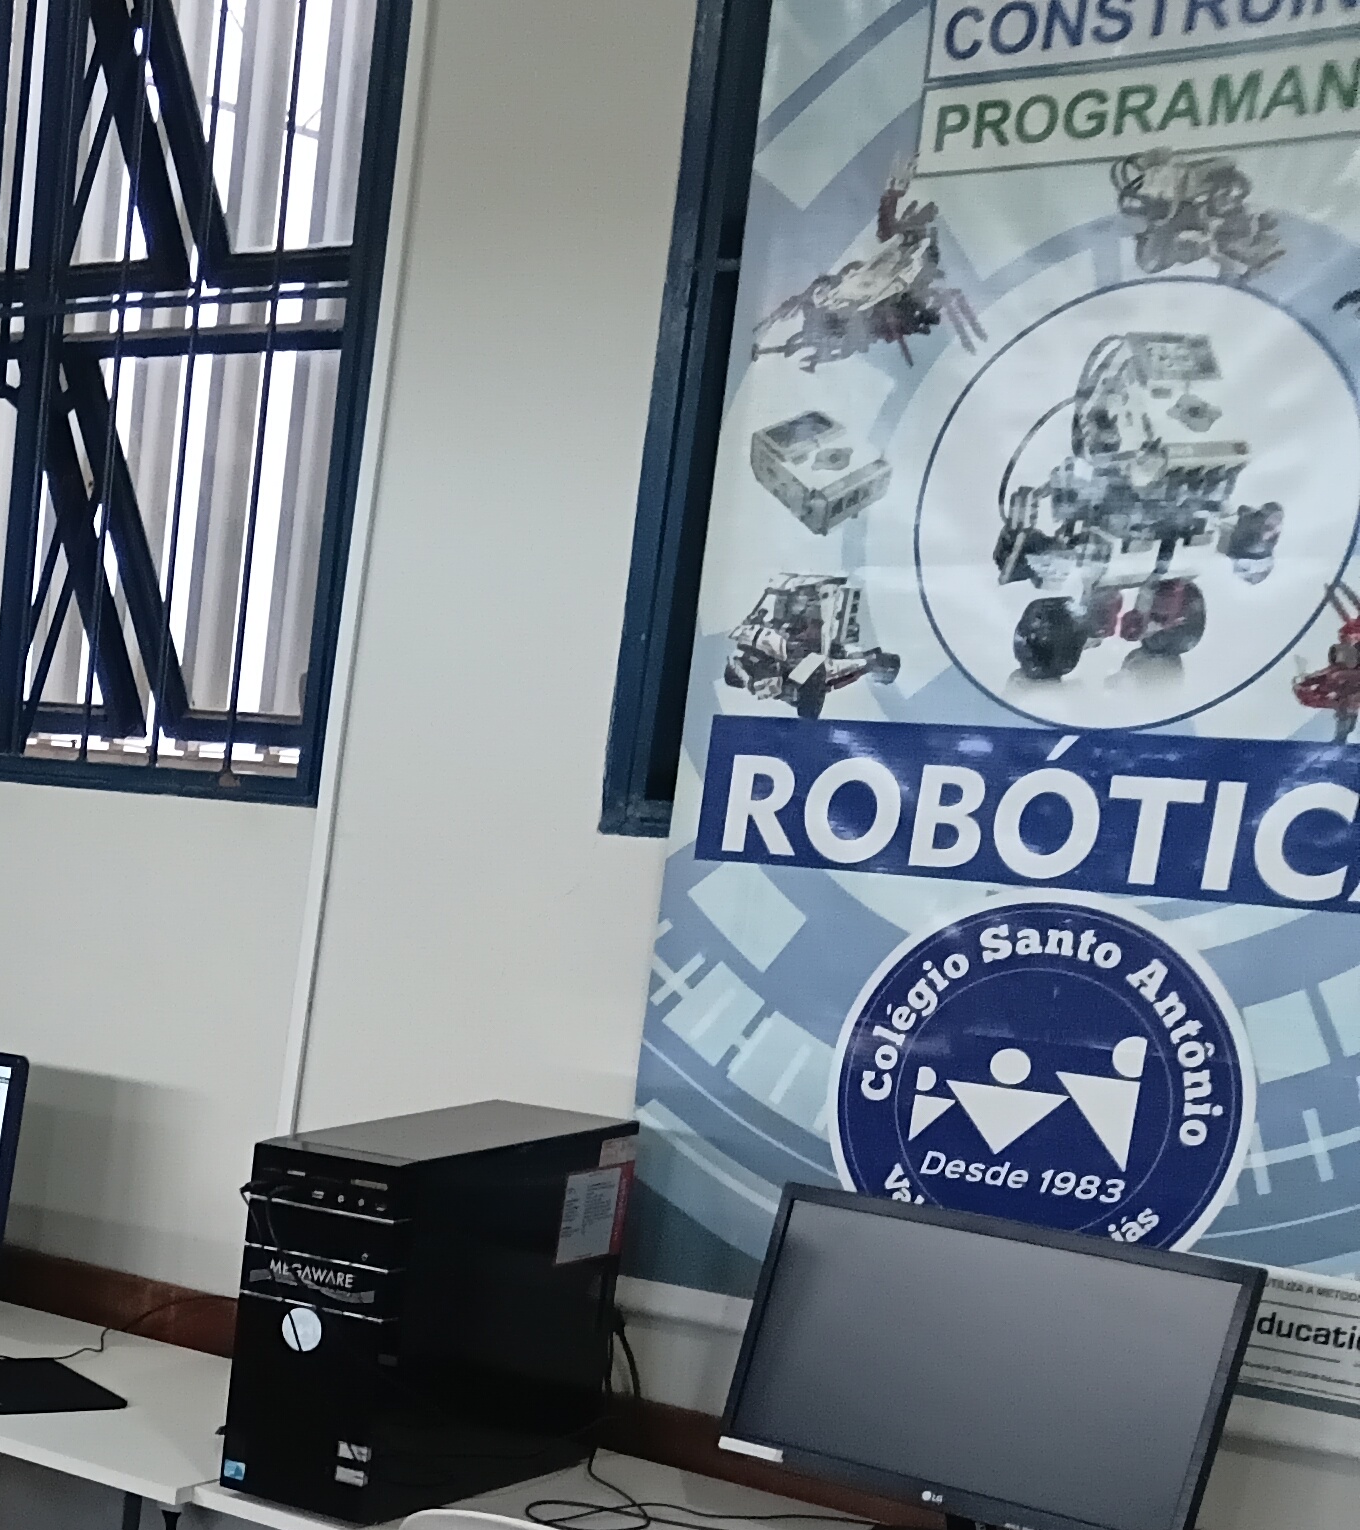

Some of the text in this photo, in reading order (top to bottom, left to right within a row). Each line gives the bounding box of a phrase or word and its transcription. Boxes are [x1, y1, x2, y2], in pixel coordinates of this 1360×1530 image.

[944, 0, 1360, 61] CONSTR
[934, 58, 1360, 152] PROGRAMAN
[721, 735, 1360, 902] ROBÓTIC
[861, 924, 1223, 1147] Colégio Santo Antônio
[884, 1162, 925, 1205] Va
[920, 1150, 1127, 1204] Desde 1983
[269, 1257, 355, 1289] MEGAWARE
[1317, 1287, 1360, 1303] METOD
[1256, 1311, 1360, 1351] ducati
